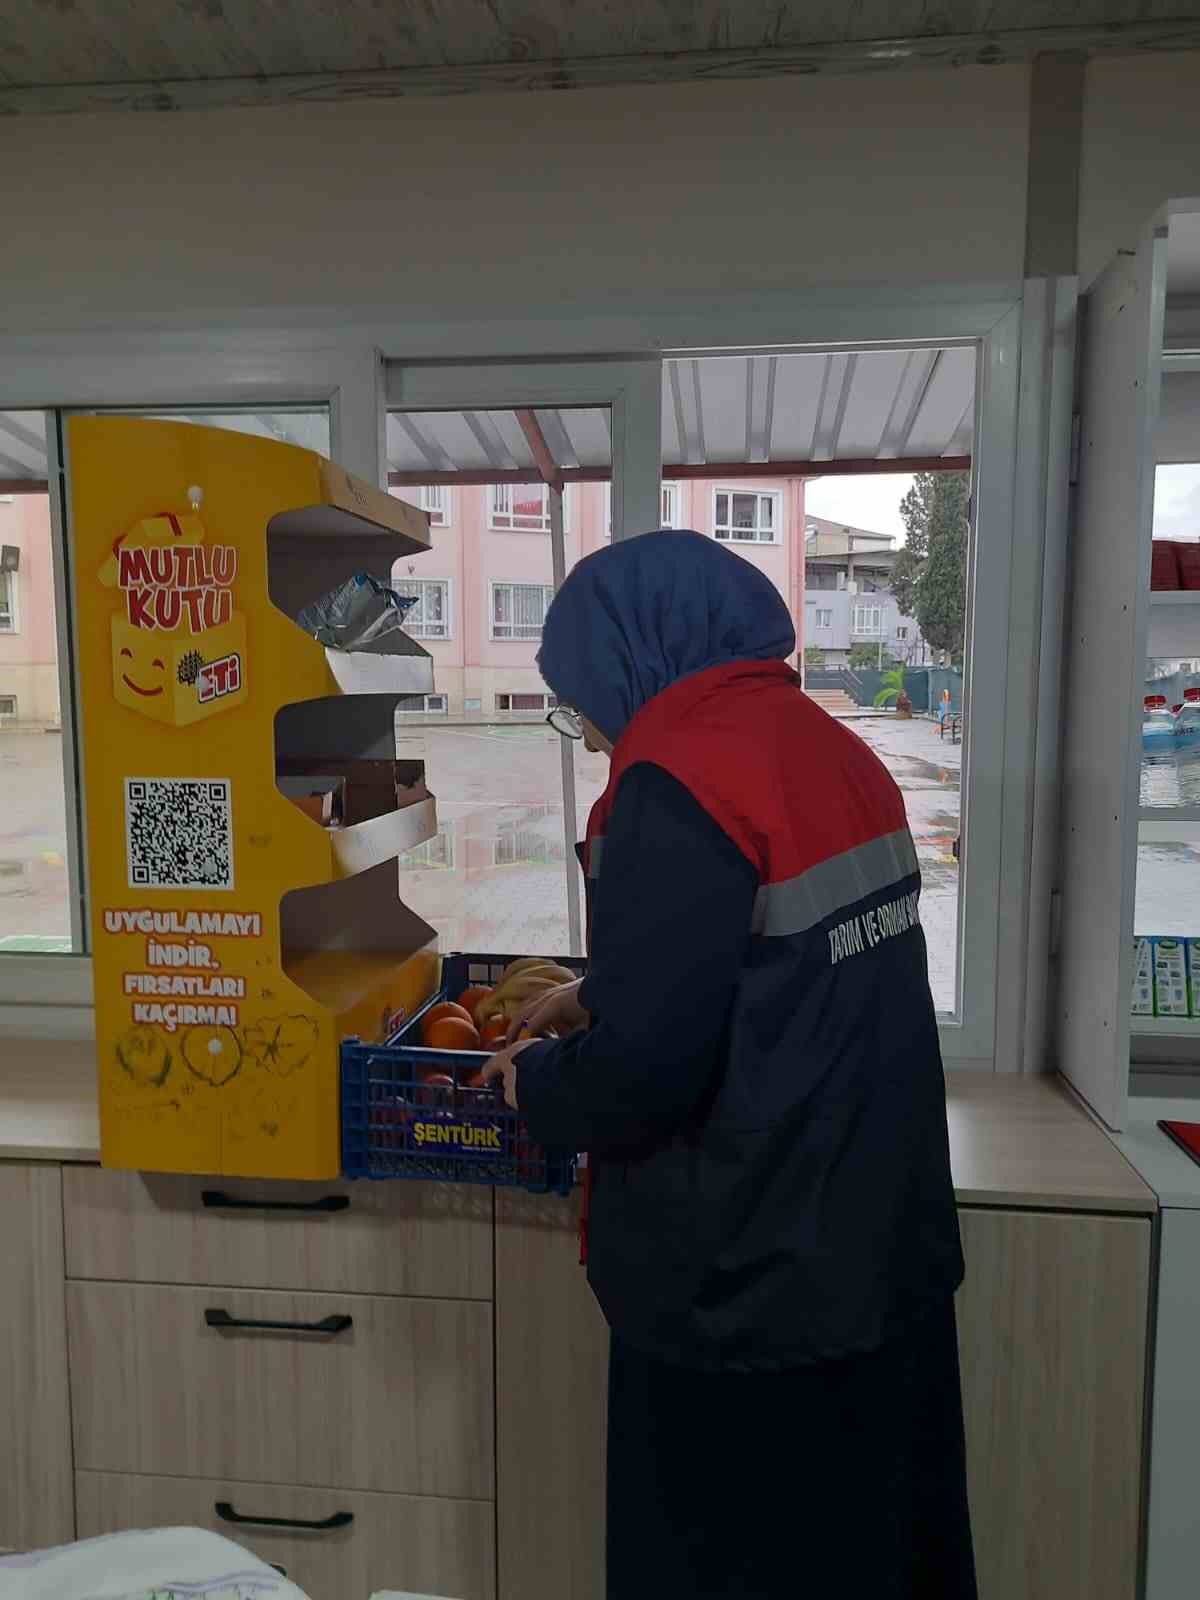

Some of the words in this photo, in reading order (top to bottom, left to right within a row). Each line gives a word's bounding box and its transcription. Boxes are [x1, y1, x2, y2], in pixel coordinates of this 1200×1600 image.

[118, 546, 237, 588] MUTLU
[127, 587, 232, 635] KUTU
[105, 911, 260, 935] UYGULAMAYI
[829, 918, 864, 964] TARIM
[862, 911, 880, 947] VE
[125, 975, 244, 997] FIRSATLARI
[414, 1122, 501, 1146] ŞENTÜRK
